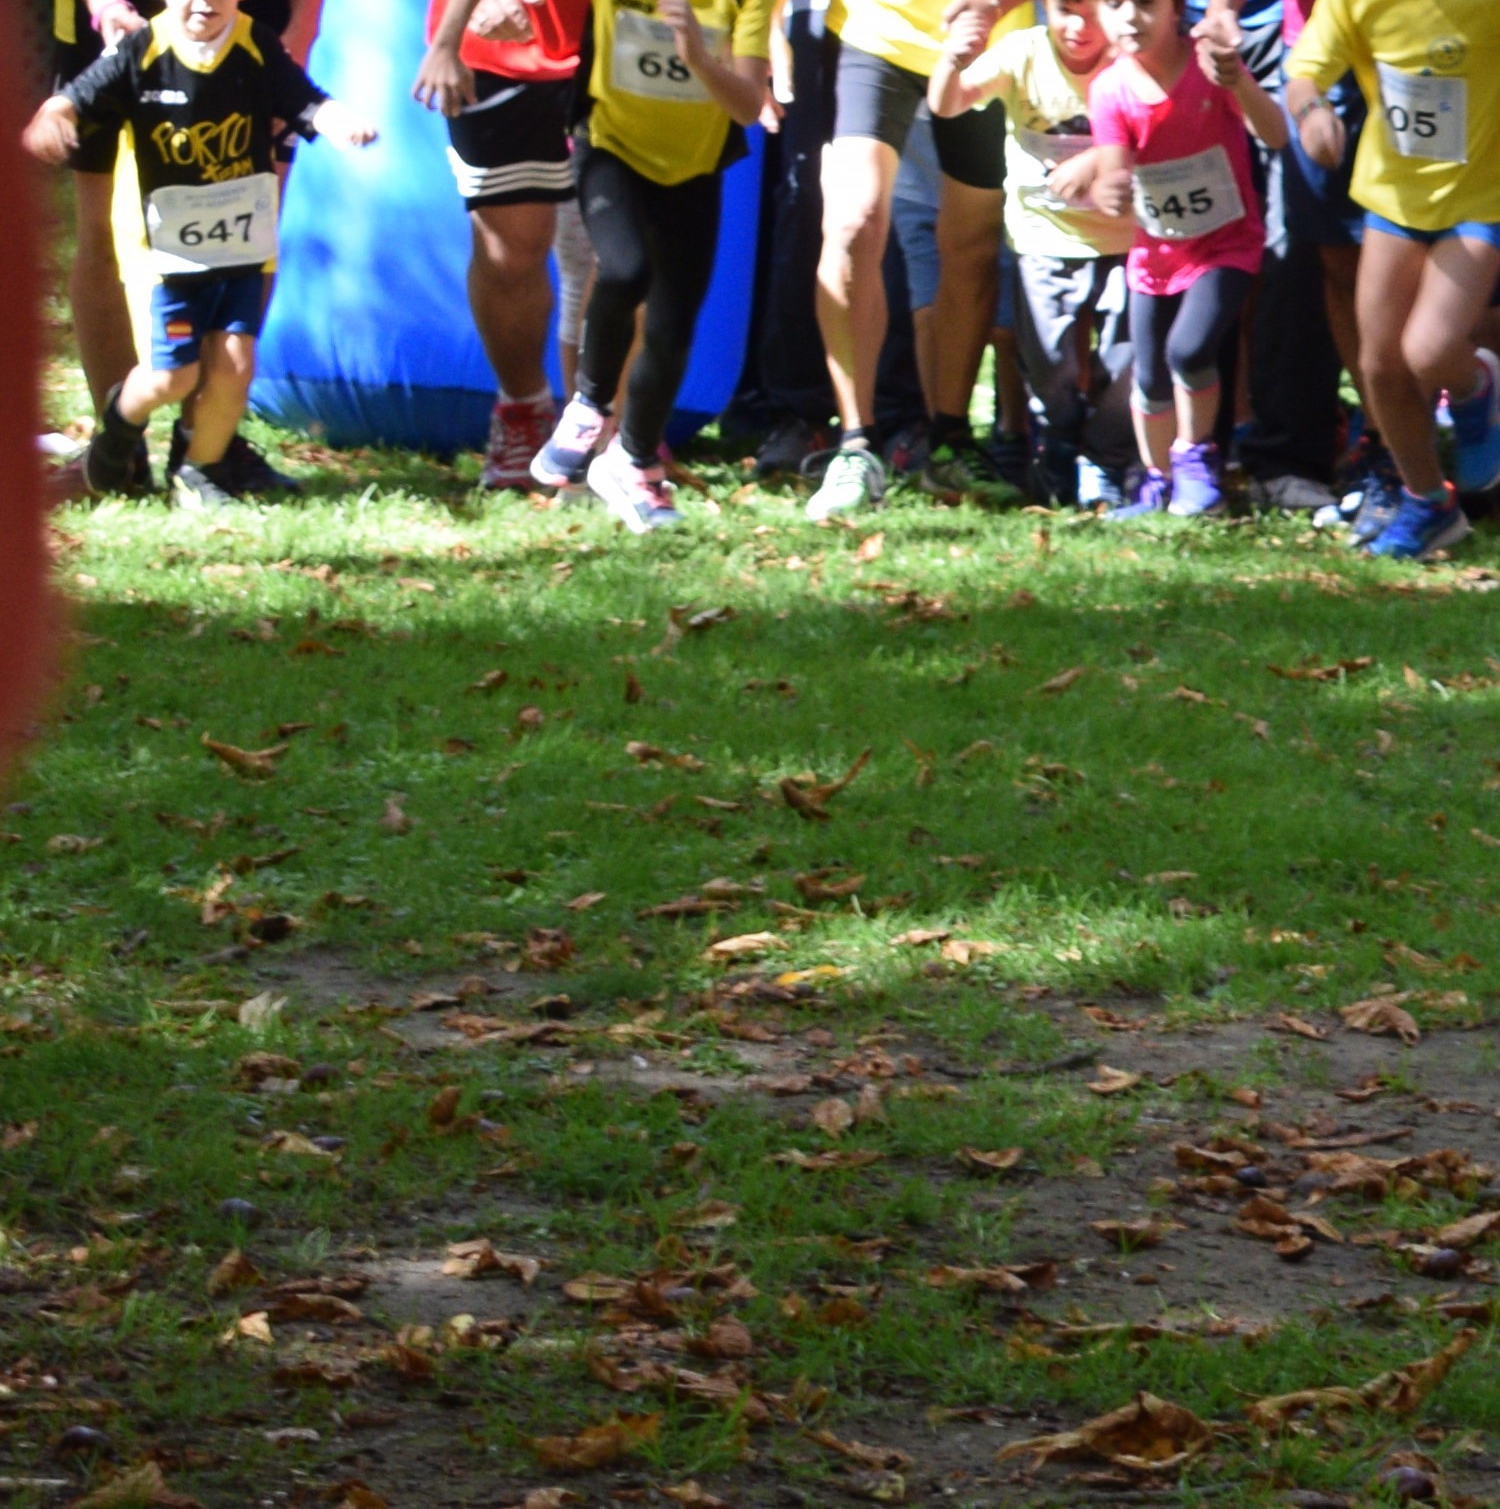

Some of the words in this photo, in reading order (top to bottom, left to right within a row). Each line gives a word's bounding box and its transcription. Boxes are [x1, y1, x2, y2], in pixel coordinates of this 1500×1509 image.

[638, 52, 690, 84] 68
[1387, 105, 1437, 138] 05
[151, 112, 252, 165] PORTO
[179, 212, 254, 246] 647
